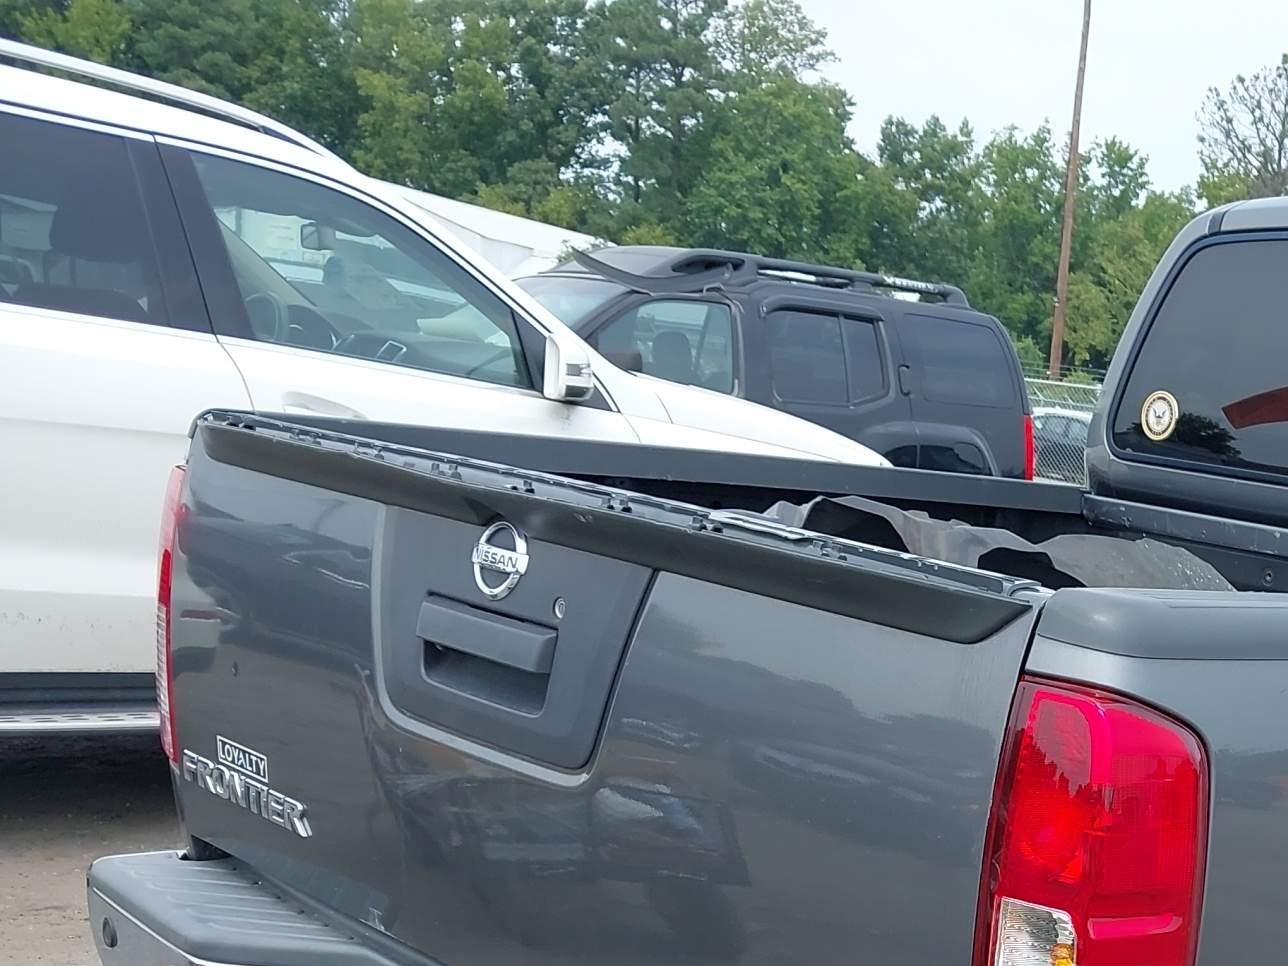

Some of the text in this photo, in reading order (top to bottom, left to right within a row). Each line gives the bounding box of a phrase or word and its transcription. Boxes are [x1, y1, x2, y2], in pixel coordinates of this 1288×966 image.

[472, 545, 519, 570] NISSAN
[218, 740, 266, 777] LOYALTY
[182, 748, 313, 838] FRONTIER
